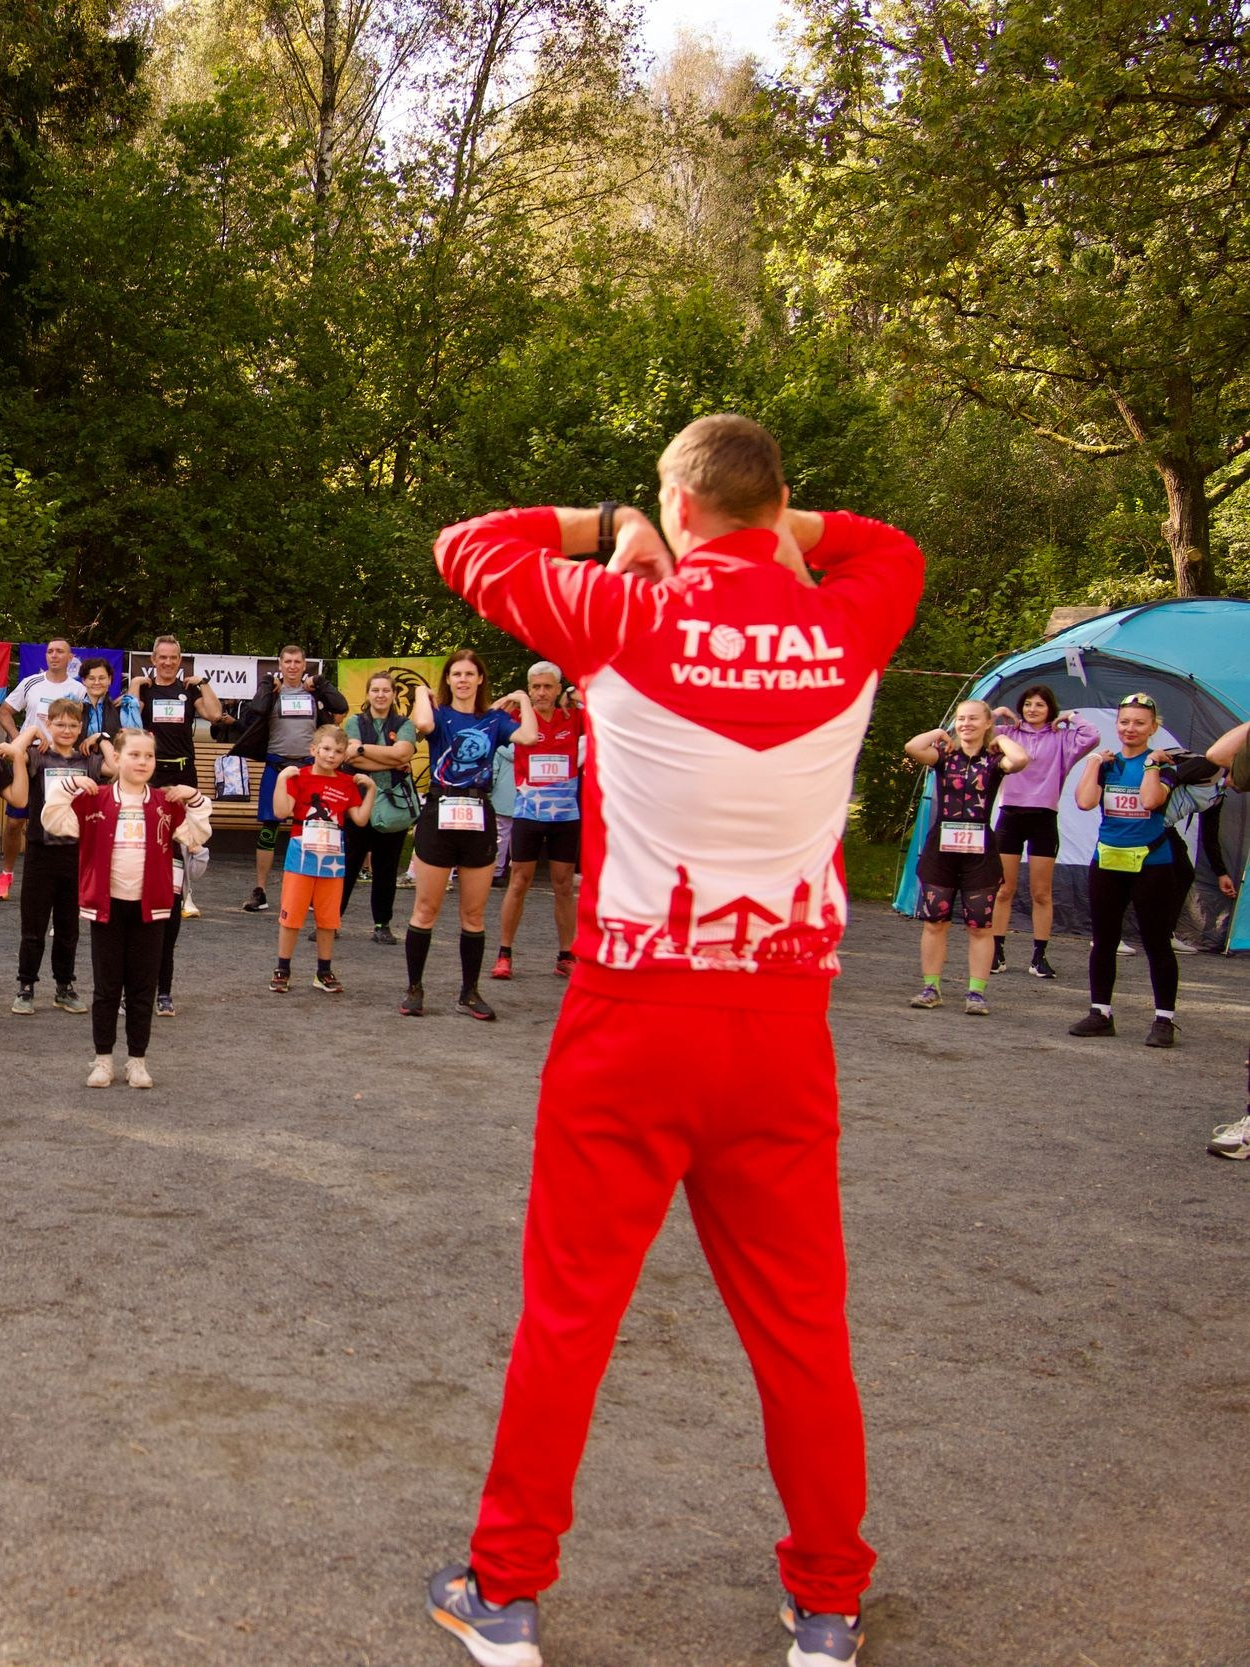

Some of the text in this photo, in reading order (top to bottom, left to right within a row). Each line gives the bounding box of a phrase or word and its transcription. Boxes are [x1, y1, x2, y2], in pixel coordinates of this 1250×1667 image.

[676, 619, 844, 663] TOTAL
[204, 669, 247, 684] УГЛИ
[670, 663, 845, 690] VOLLEYBALL
[164, 706, 174, 716] 12
[293, 701, 302, 709] 14
[541, 763, 558, 774] 170
[1114, 795, 1138, 809] 129
[450, 807, 473, 820] 168
[953, 831, 973, 844] 127
